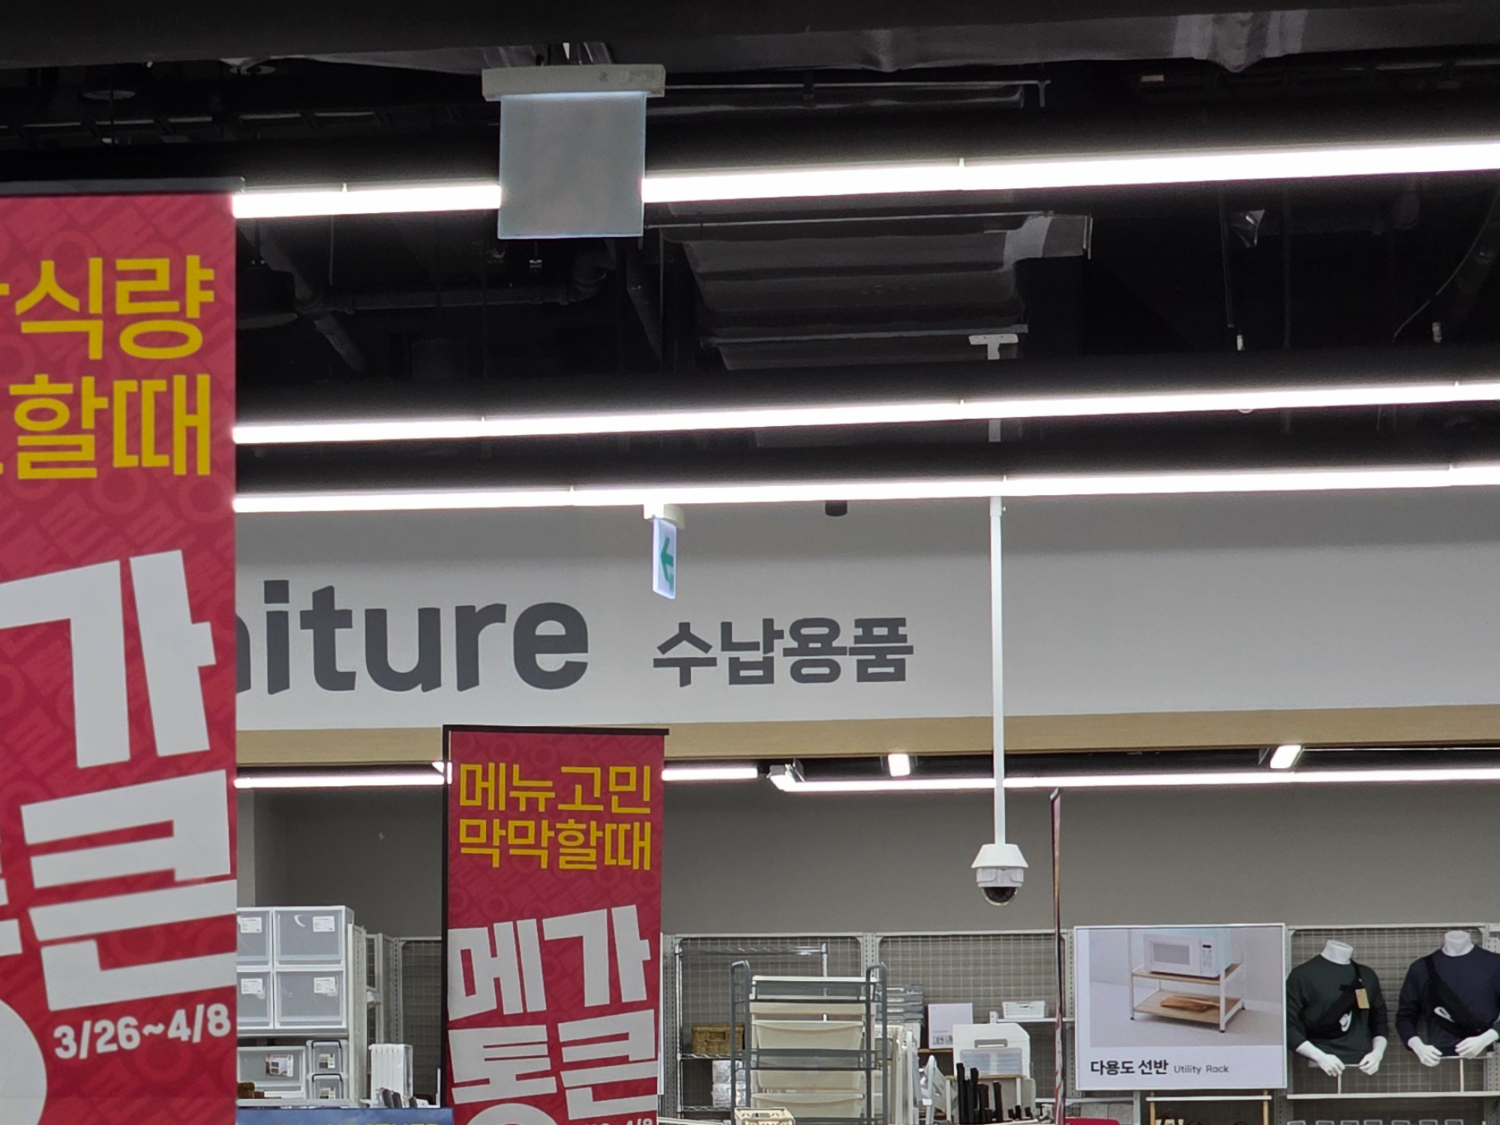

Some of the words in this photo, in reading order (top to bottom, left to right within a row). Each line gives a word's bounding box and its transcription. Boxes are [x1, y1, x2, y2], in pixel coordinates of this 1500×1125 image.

[652, 617, 914, 687] 수납용품
[459, 762, 652, 814] 메뉴고민
[460, 819, 652, 871] 막막할때
[447, 904, 651, 1021] 메가
[54, 1003, 231, 1060] 3/26~4/8
[1090, 1060, 1135, 1076] 다용도
[1138, 1059, 1169, 1075] 선반
[1174, 1064, 1202, 1075] Utility
[1205, 1064, 1229, 1074] Rack
